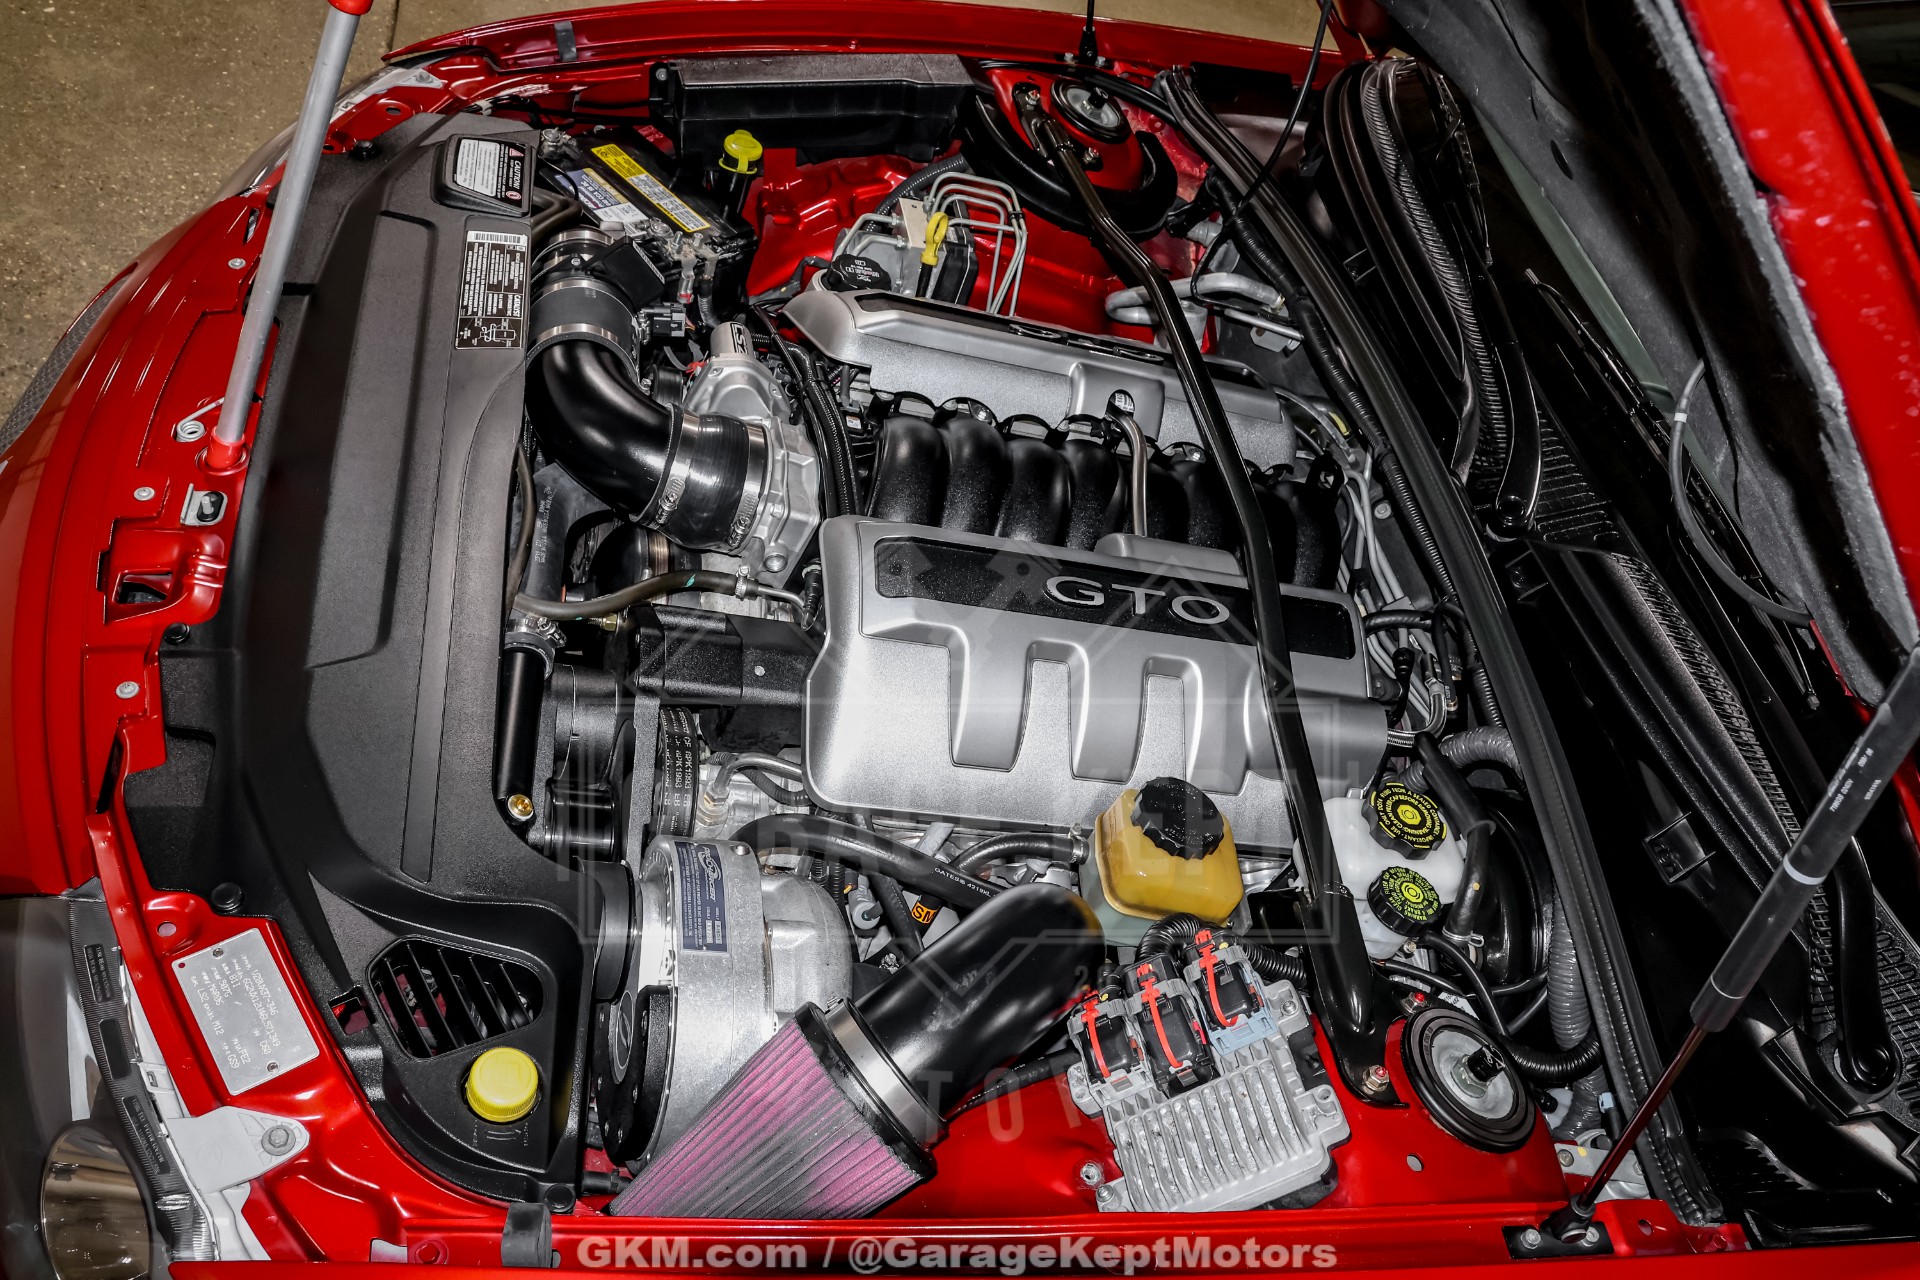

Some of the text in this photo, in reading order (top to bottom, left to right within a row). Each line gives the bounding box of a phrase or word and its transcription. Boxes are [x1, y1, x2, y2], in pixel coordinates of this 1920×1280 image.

[733, 322, 747, 356] LS2
[1043, 576, 1230, 624] GTO
[1412, 792, 1432, 808] SEALED
[1386, 812, 1403, 829] CLEAN
